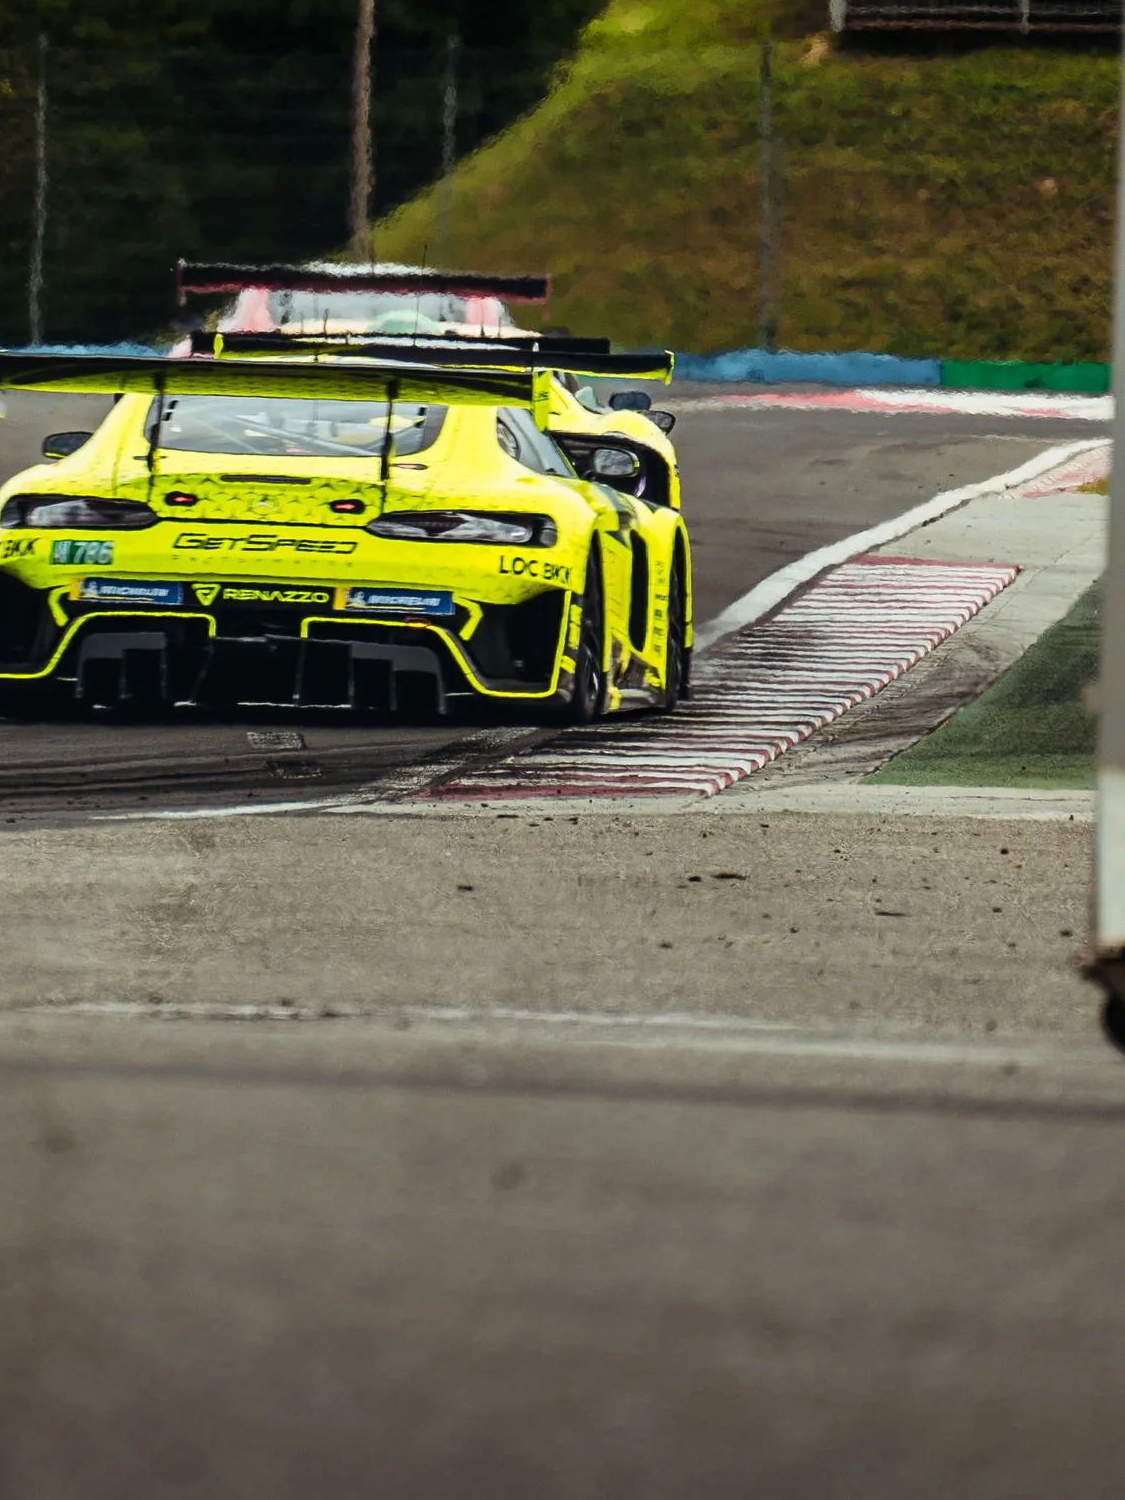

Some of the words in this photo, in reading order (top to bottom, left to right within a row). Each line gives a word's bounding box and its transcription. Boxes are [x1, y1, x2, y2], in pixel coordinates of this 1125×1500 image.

[73, 540, 115, 564] 786
[498, 554, 539, 577] LOC
[222, 588, 330, 604] RENAZZO
